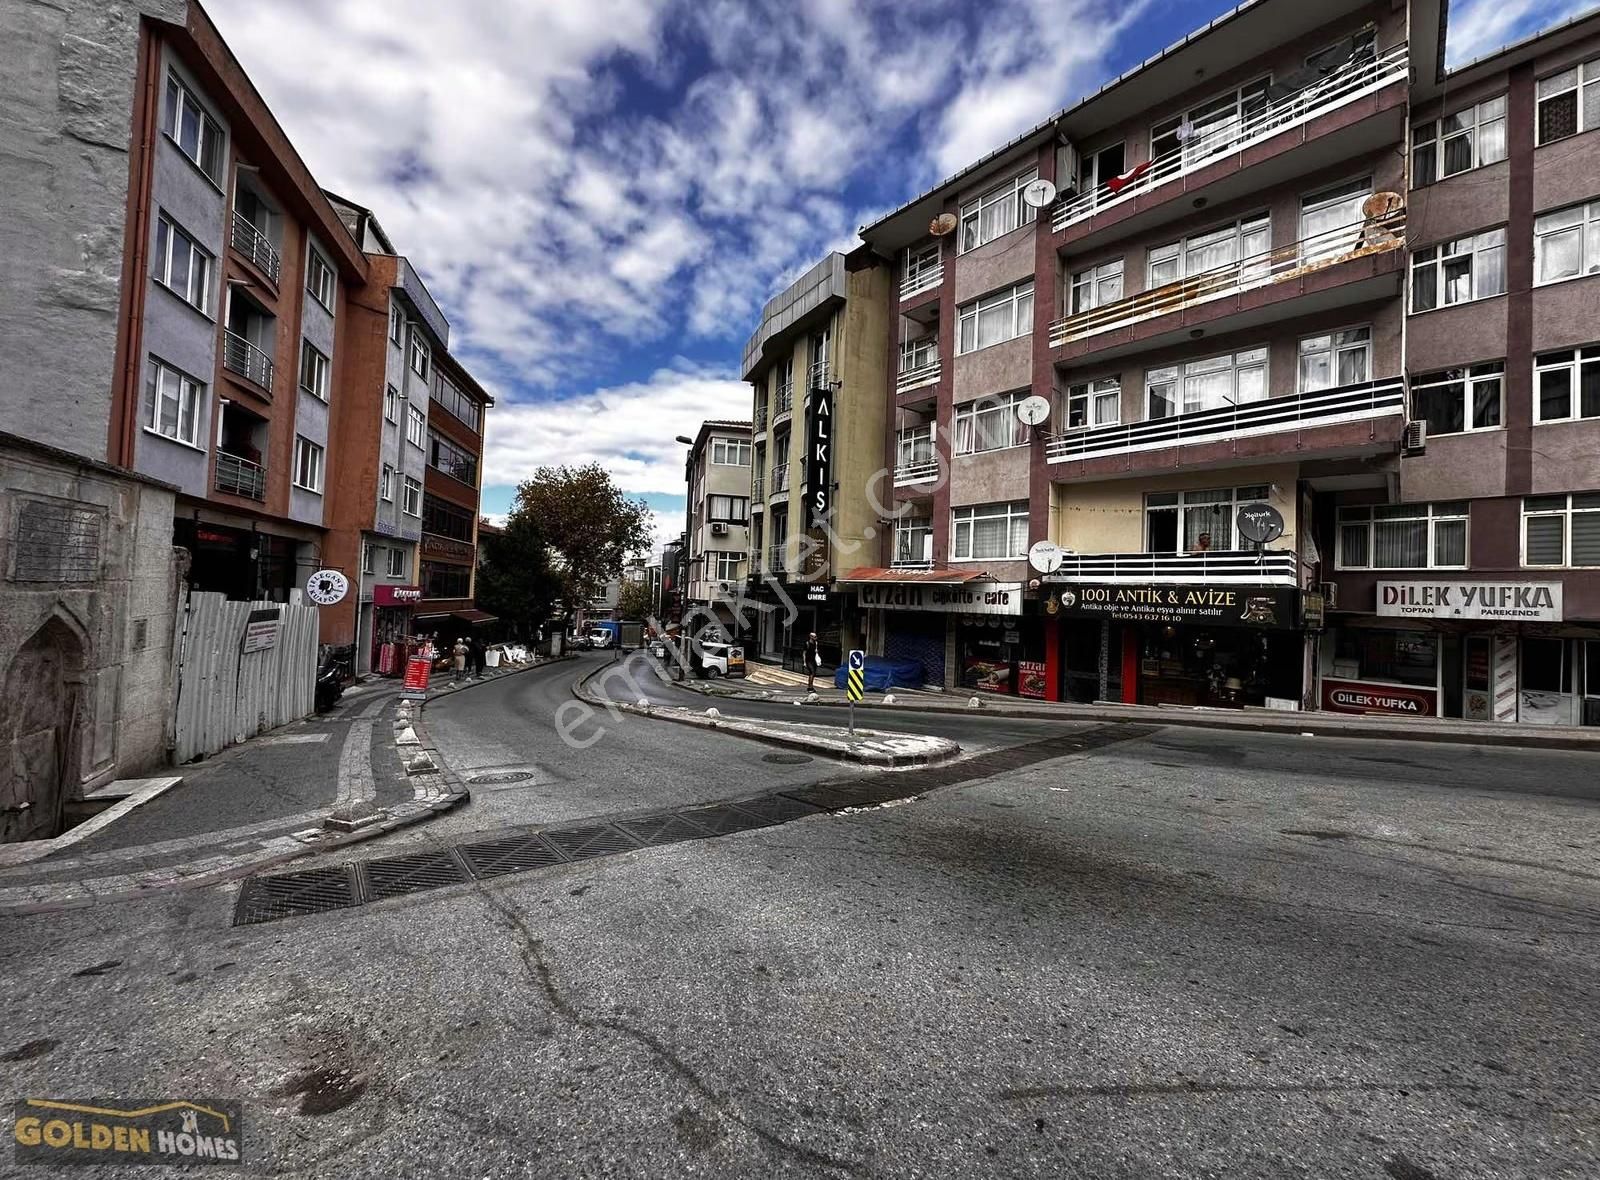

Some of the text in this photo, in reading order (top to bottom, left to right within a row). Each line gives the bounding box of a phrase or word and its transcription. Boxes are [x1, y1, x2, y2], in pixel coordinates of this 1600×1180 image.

[816, 399, 829, 512] ALKIŞ
[810, 585, 825, 593] HAC
[807, 593, 827, 601] UMRE
[984, 590, 1009, 605] cafe
[1081, 587, 1236, 606] 1001 ANTİK & AVİZE
[1460, 587, 1553, 608] YUFKA
[1080, 602, 1102, 610] Antika
[1103, 603, 1119, 612] obje
[1130, 604, 1155, 613] Antika
[1373, 697, 1417, 710] YUFKA
